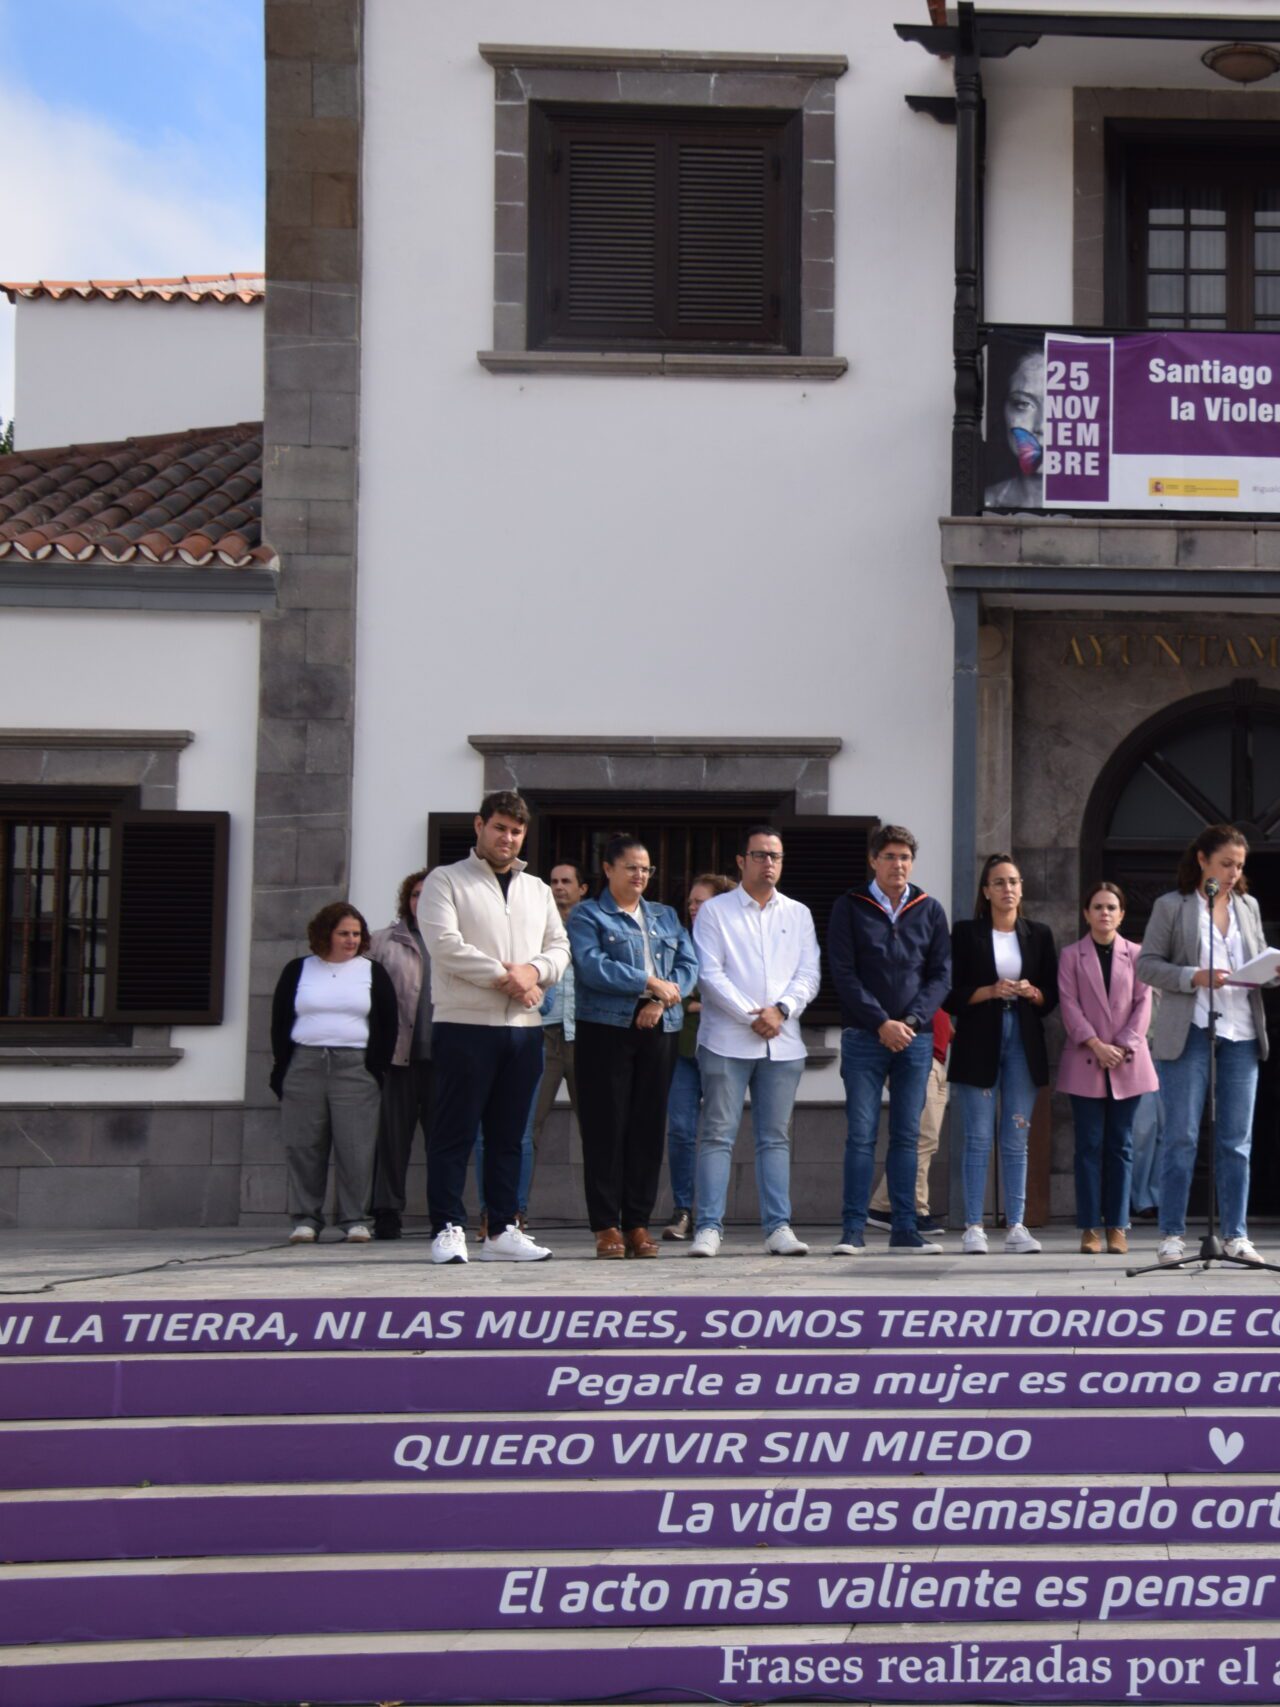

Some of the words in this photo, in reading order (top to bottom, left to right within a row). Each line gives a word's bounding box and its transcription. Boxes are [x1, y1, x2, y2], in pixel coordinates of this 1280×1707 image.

[1046, 360, 1090, 391] 25
[1148, 358, 1273, 390] Santiago
[1046, 394, 1100, 420] NOV
[1170, 396, 1196, 421] la
[1045, 450, 1100, 476] BRE
[44, 1314, 104, 1344] LA
[122, 1311, 299, 1346] TIERRA,
[313, 1311, 367, 1340] NI
[377, 1310, 465, 1339] LAS
[475, 1309, 687, 1344] MUJERES,
[700, 1309, 865, 1338] SOMOS
[877, 1308, 1166, 1338] TERRITORIOS
[1176, 1308, 1237, 1337] DE
[547, 1364, 724, 1405] Pegarle
[734, 1373, 762, 1396] a
[775, 1372, 861, 1396] una
[873, 1363, 1010, 1403] mujer
[1019, 1371, 1068, 1394] es
[1079, 1371, 1201, 1394] como
[393, 1433, 595, 1472] QUIERO
[612, 1432, 748, 1464] VIVIR
[759, 1431, 850, 1463] SIN
[862, 1429, 1032, 1462] MIEDO
[657, 1491, 715, 1534] La
[730, 1489, 832, 1533] vida
[846, 1500, 900, 1532] es
[912, 1488, 1178, 1531] demasiado
[498, 1567, 548, 1614] El
[559, 1572, 670, 1614] acto
[683, 1567, 791, 1610] más
[818, 1563, 1022, 1609] valiente
[1035, 1575, 1089, 1608] es
[1098, 1574, 1277, 1621] pensar
[719, 1646, 864, 1685] Frases
[877, 1643, 1112, 1684] realizadas
[1126, 1657, 1205, 1697] por
[1218, 1645, 1259, 1685] el
